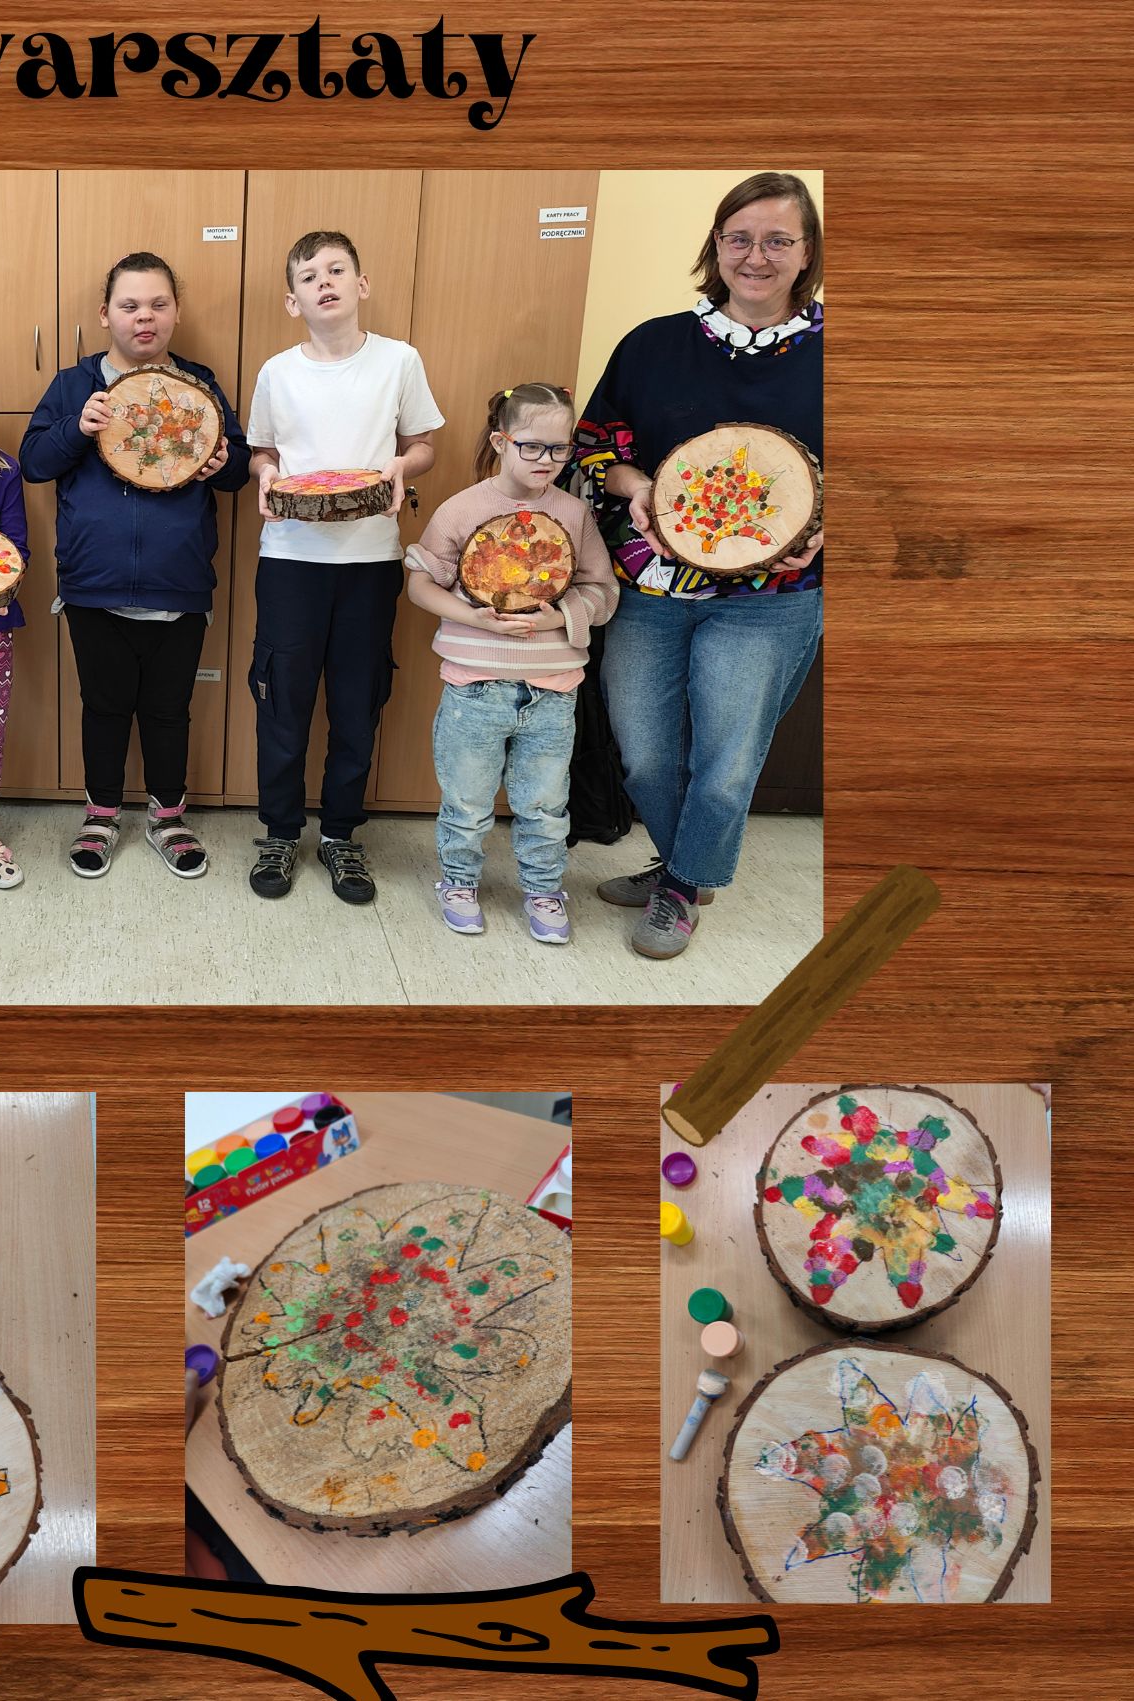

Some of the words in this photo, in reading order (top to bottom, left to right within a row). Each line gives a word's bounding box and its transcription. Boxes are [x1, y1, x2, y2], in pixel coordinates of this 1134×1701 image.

[541, 229, 585, 237] PODRĘCZNIKI
[245, 1181, 269, 1197] Poster
[271, 1168, 294, 1186] paints
[197, 1198, 211, 1209] 12
